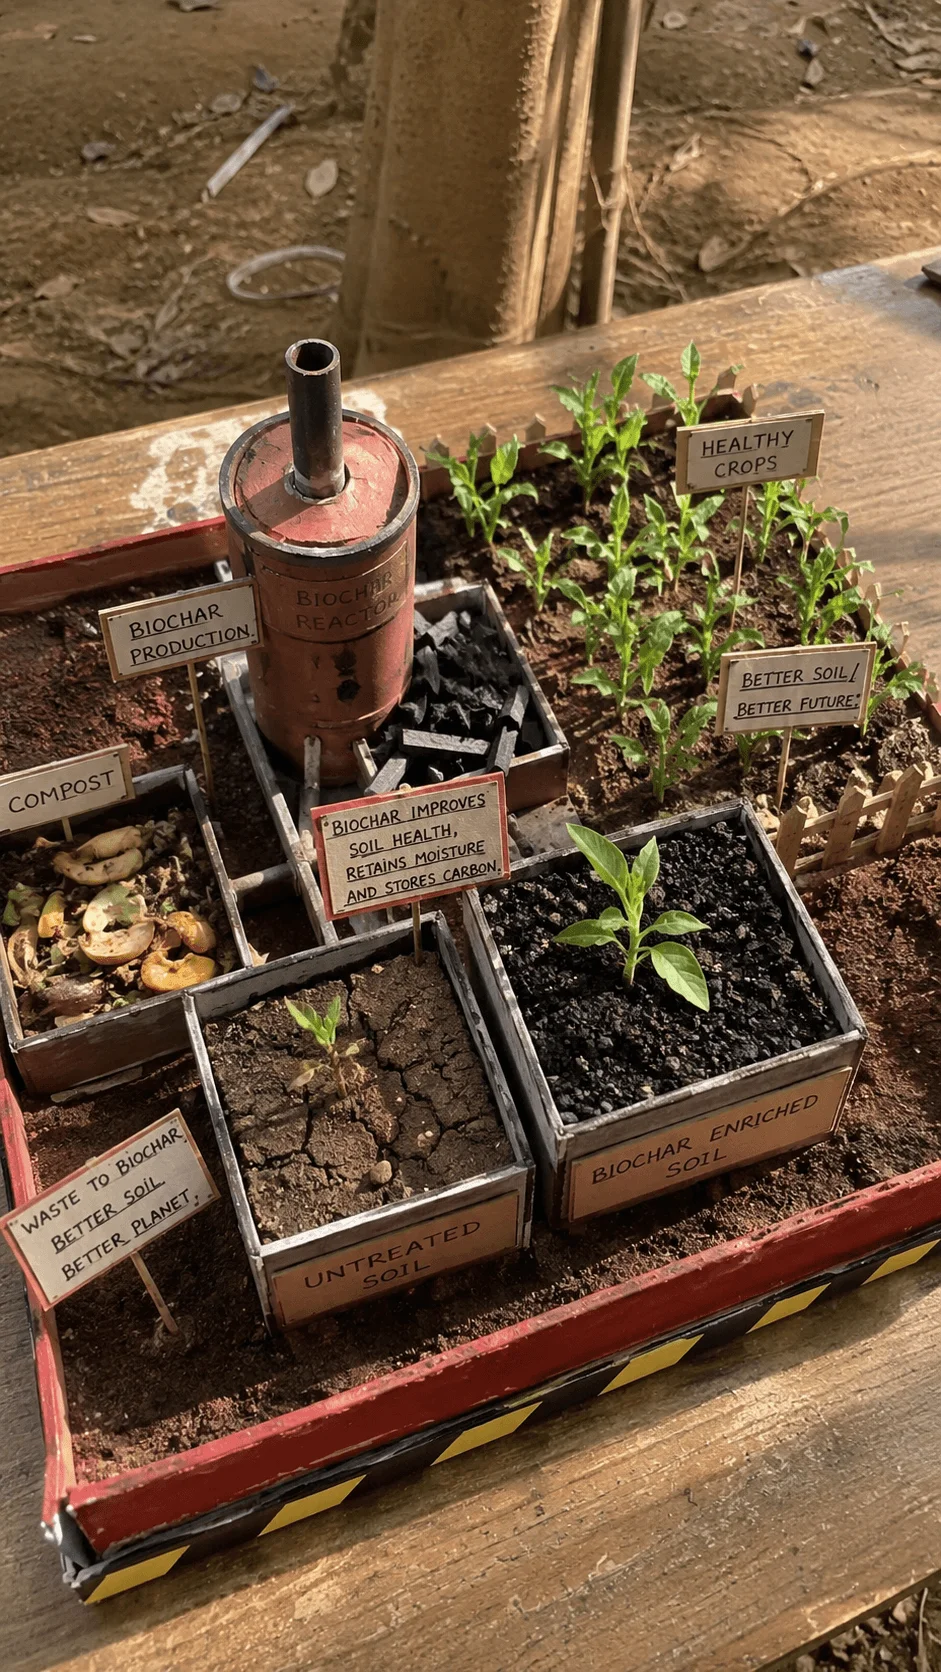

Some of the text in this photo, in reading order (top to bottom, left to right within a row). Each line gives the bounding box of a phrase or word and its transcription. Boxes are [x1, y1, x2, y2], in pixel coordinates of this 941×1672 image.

[702, 430, 794, 456] HEALTHY
[714, 455, 777, 478] CROPS
[296, 571, 392, 607] BIOCHAR
[129, 604, 223, 639] BIOCHAR
[296, 592, 399, 630] REACTOR
[130, 624, 254, 665] PRODUCTION.
[741, 669, 803, 688] BETTER
[737, 699, 791, 717] BETTER
[8, 769, 114, 813] COMPOST
[332, 793, 486, 836] BIOCHAR IMPROVES
[350, 823, 458, 858] SOIL HEALTH,
[347, 860, 502, 904] AND STORES CARBON.
[592, 1094, 819, 1185] BIOCHAR ENRICHED
[665, 1148, 727, 1179] SOIL
[21, 1190, 81, 1235] WASTE
[87, 1173, 110, 1192] TO
[51, 1203, 117, 1252] BETTER
[61, 1232, 125, 1281] BETTER
[304, 1221, 480, 1289] UNTREATED
[362, 1260, 431, 1290] SOIL
